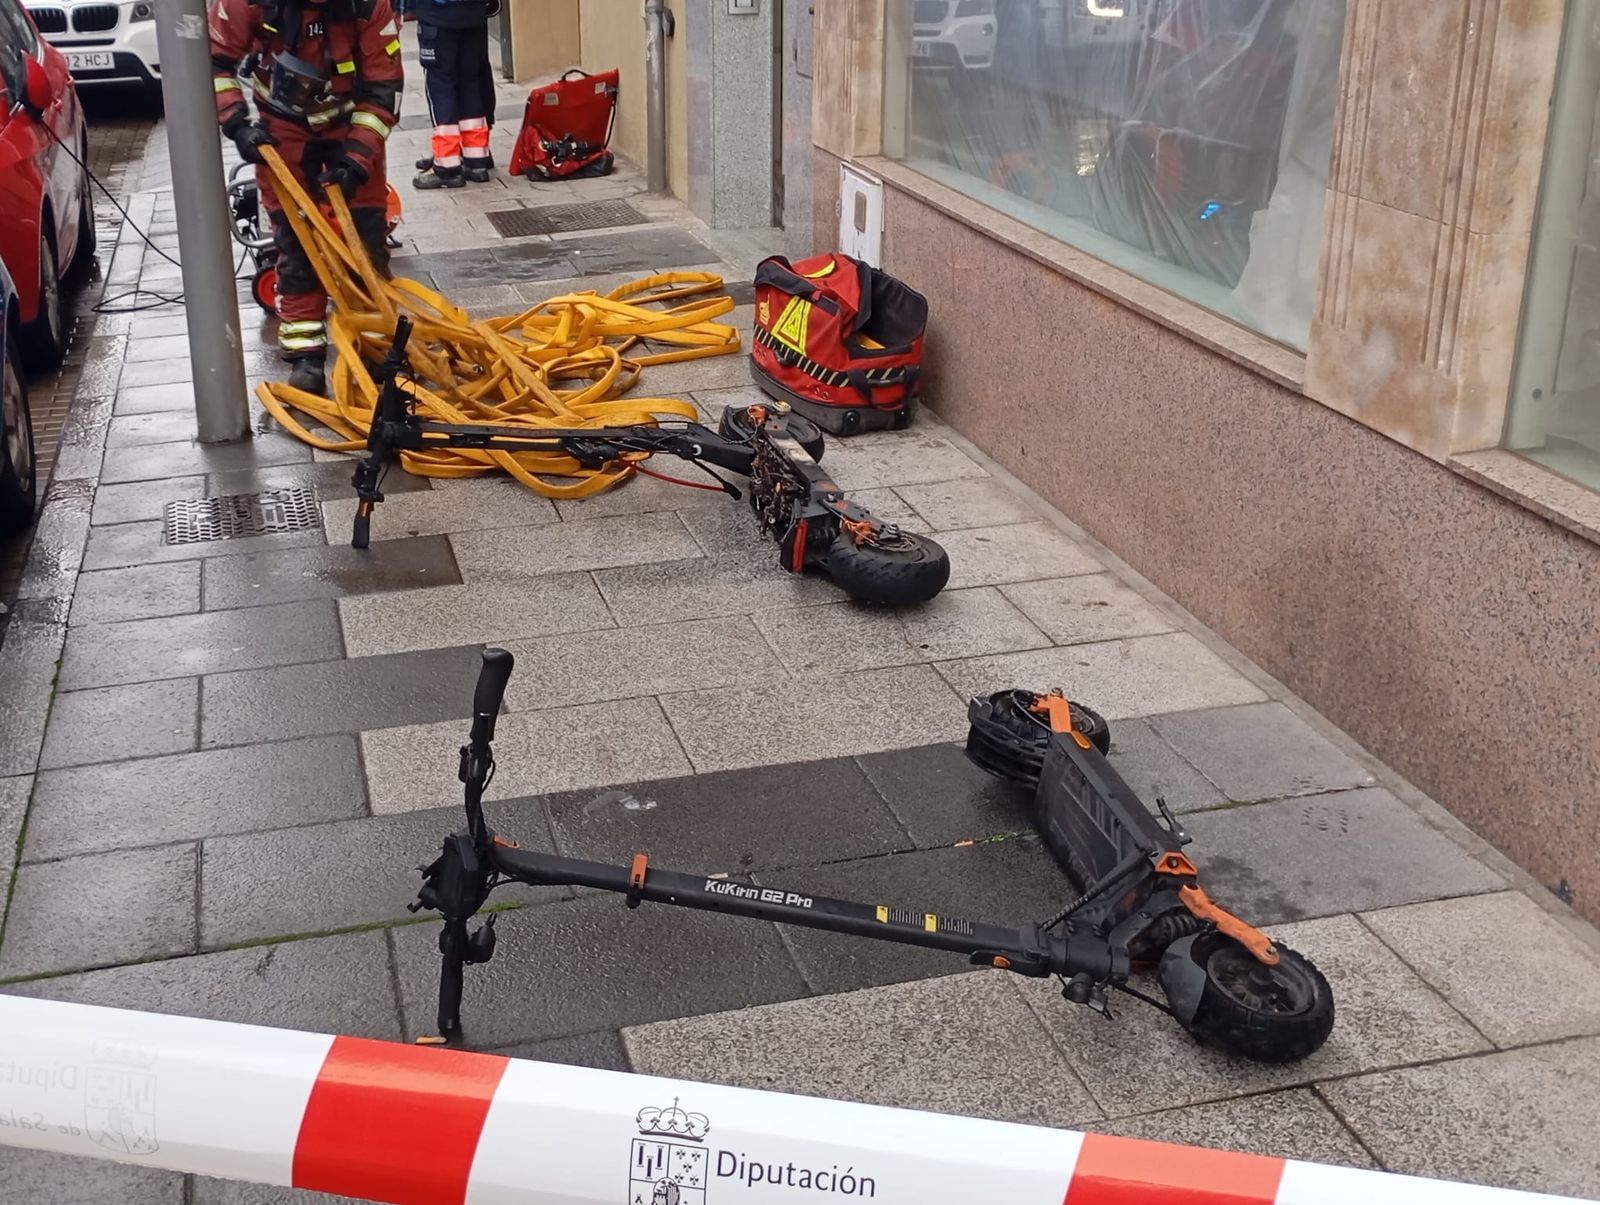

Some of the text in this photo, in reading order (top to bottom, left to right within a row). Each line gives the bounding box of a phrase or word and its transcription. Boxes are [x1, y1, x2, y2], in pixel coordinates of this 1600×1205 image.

[85, 54, 109, 66] HCJ
[704, 879, 813, 908] KuKirin G2 Pro
[717, 1149, 876, 1197] Diputación
